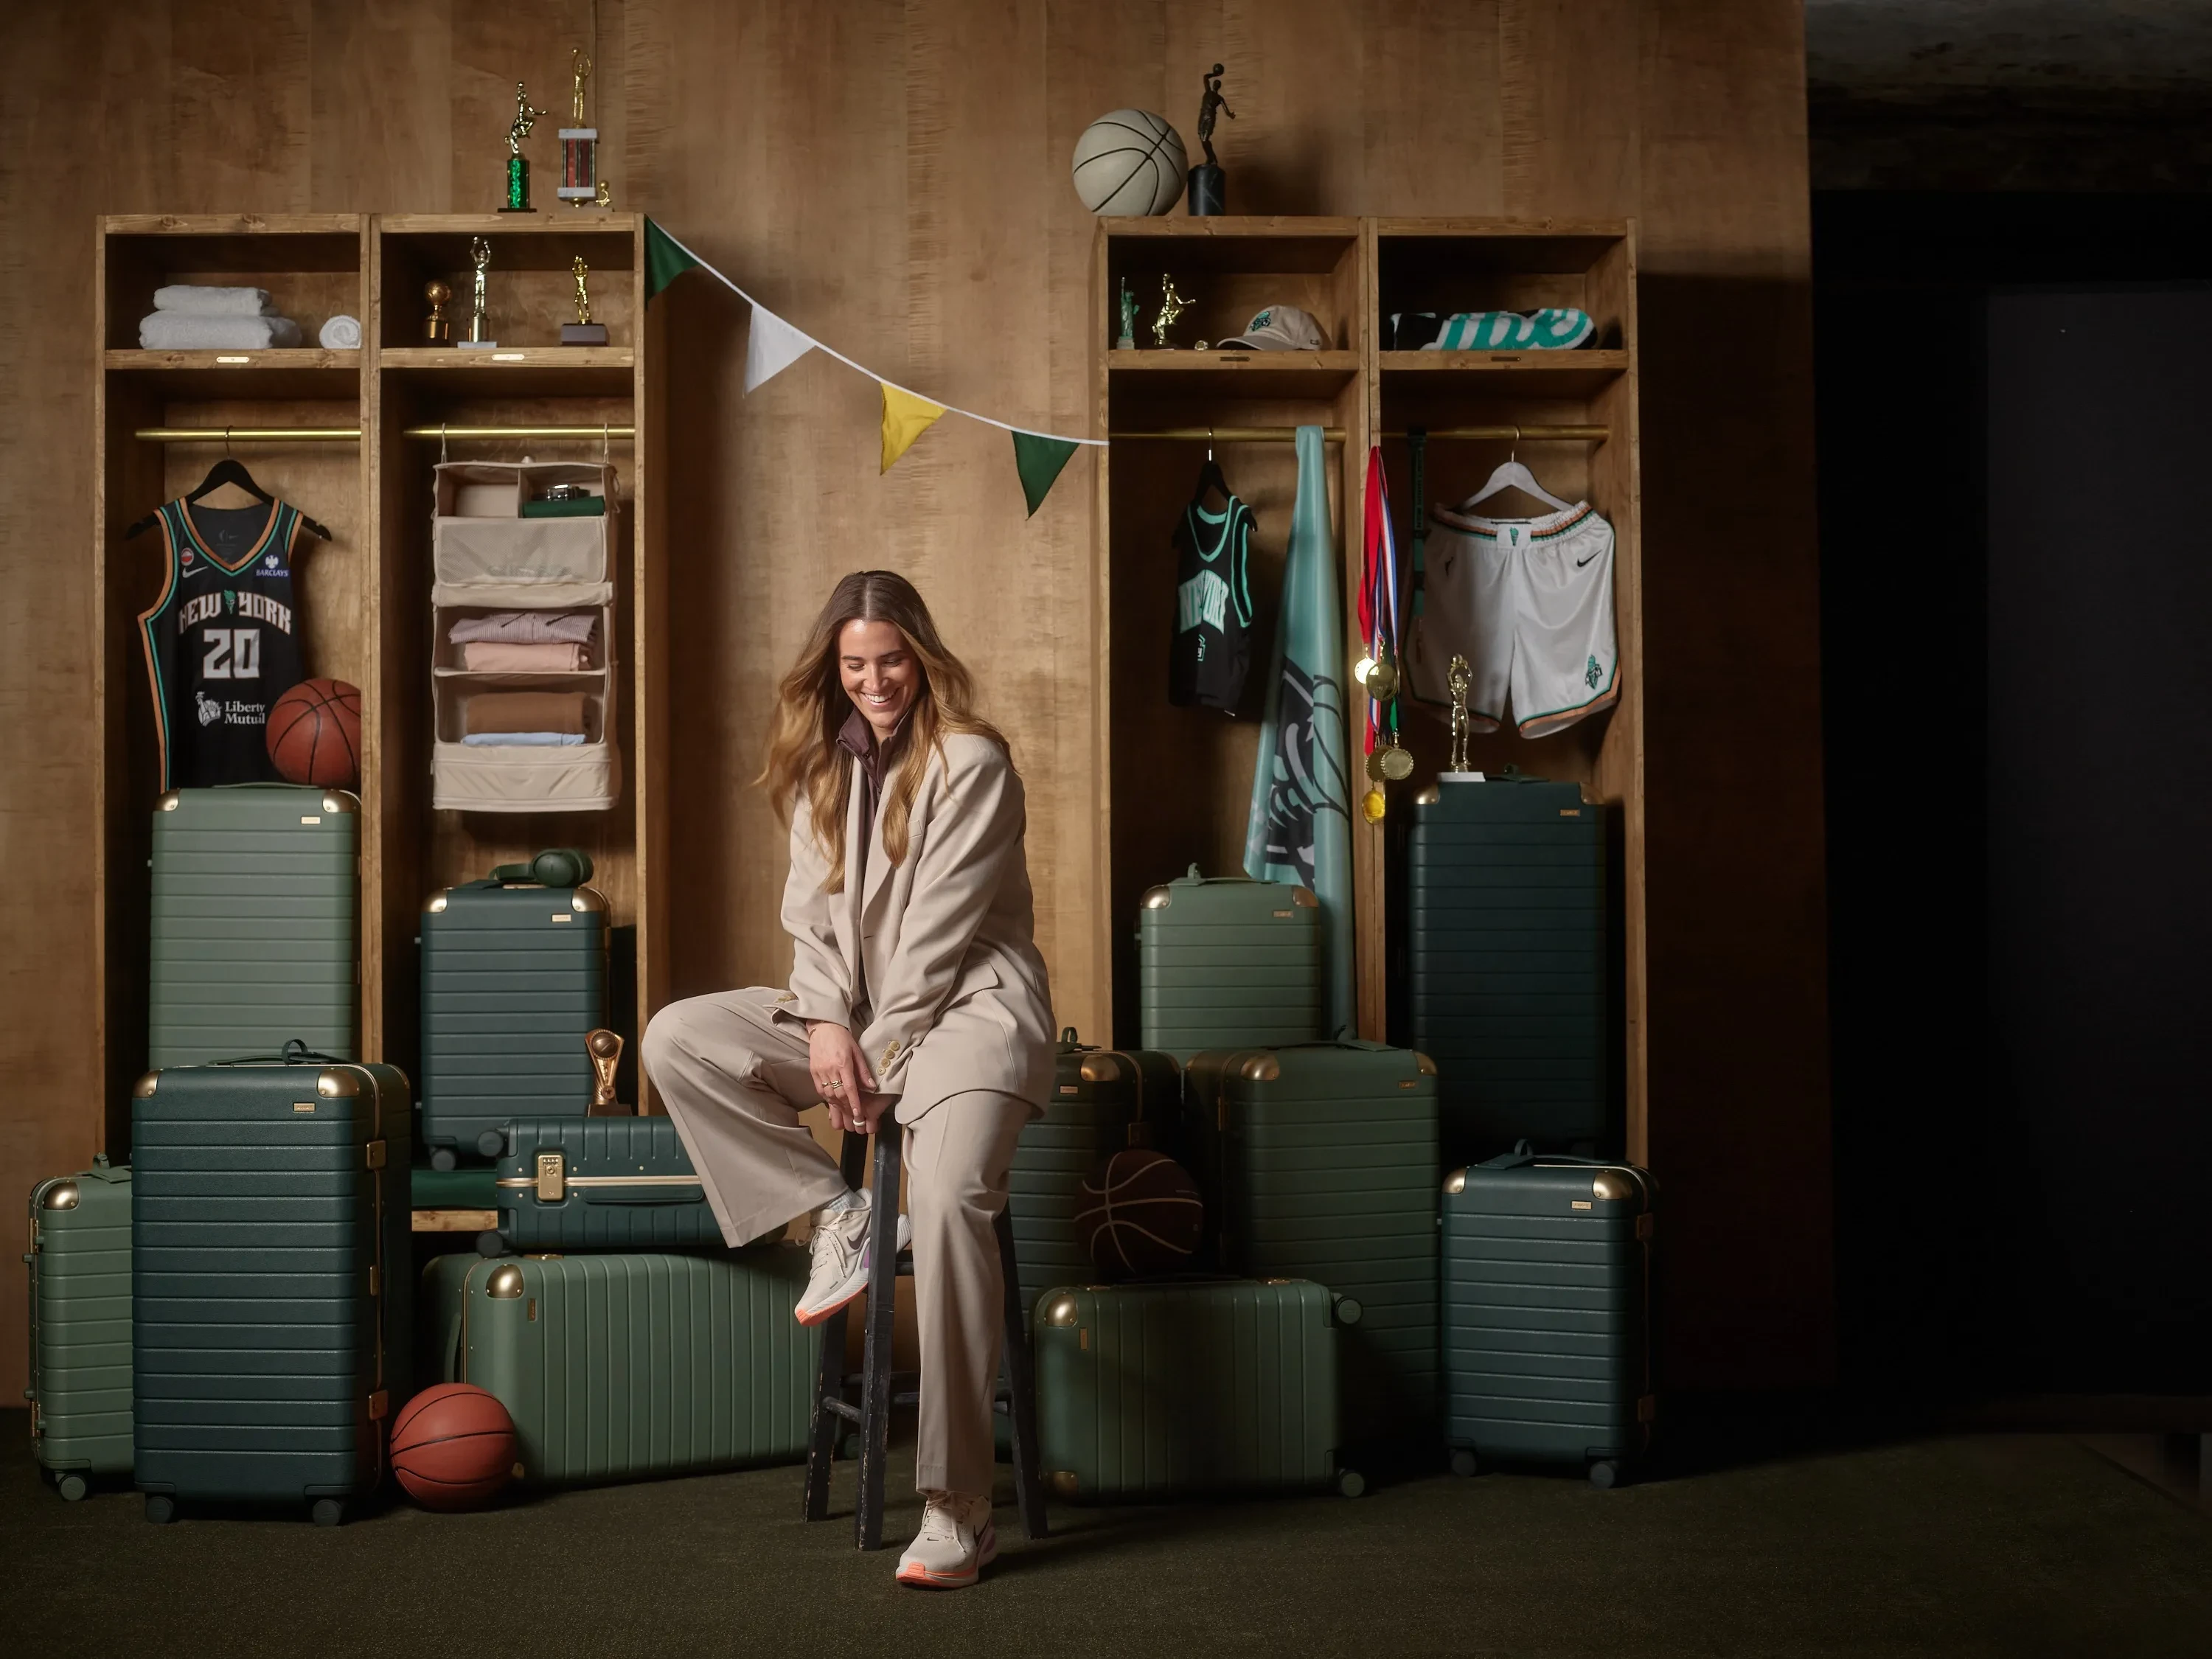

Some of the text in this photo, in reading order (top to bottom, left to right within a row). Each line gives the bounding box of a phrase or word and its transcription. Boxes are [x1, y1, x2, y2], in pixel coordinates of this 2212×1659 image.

[178, 591, 291, 636] NEW YORK
[203, 628, 261, 679] 20
[223, 712, 265, 724] Mutual
[224, 700, 265, 713] Liberty
